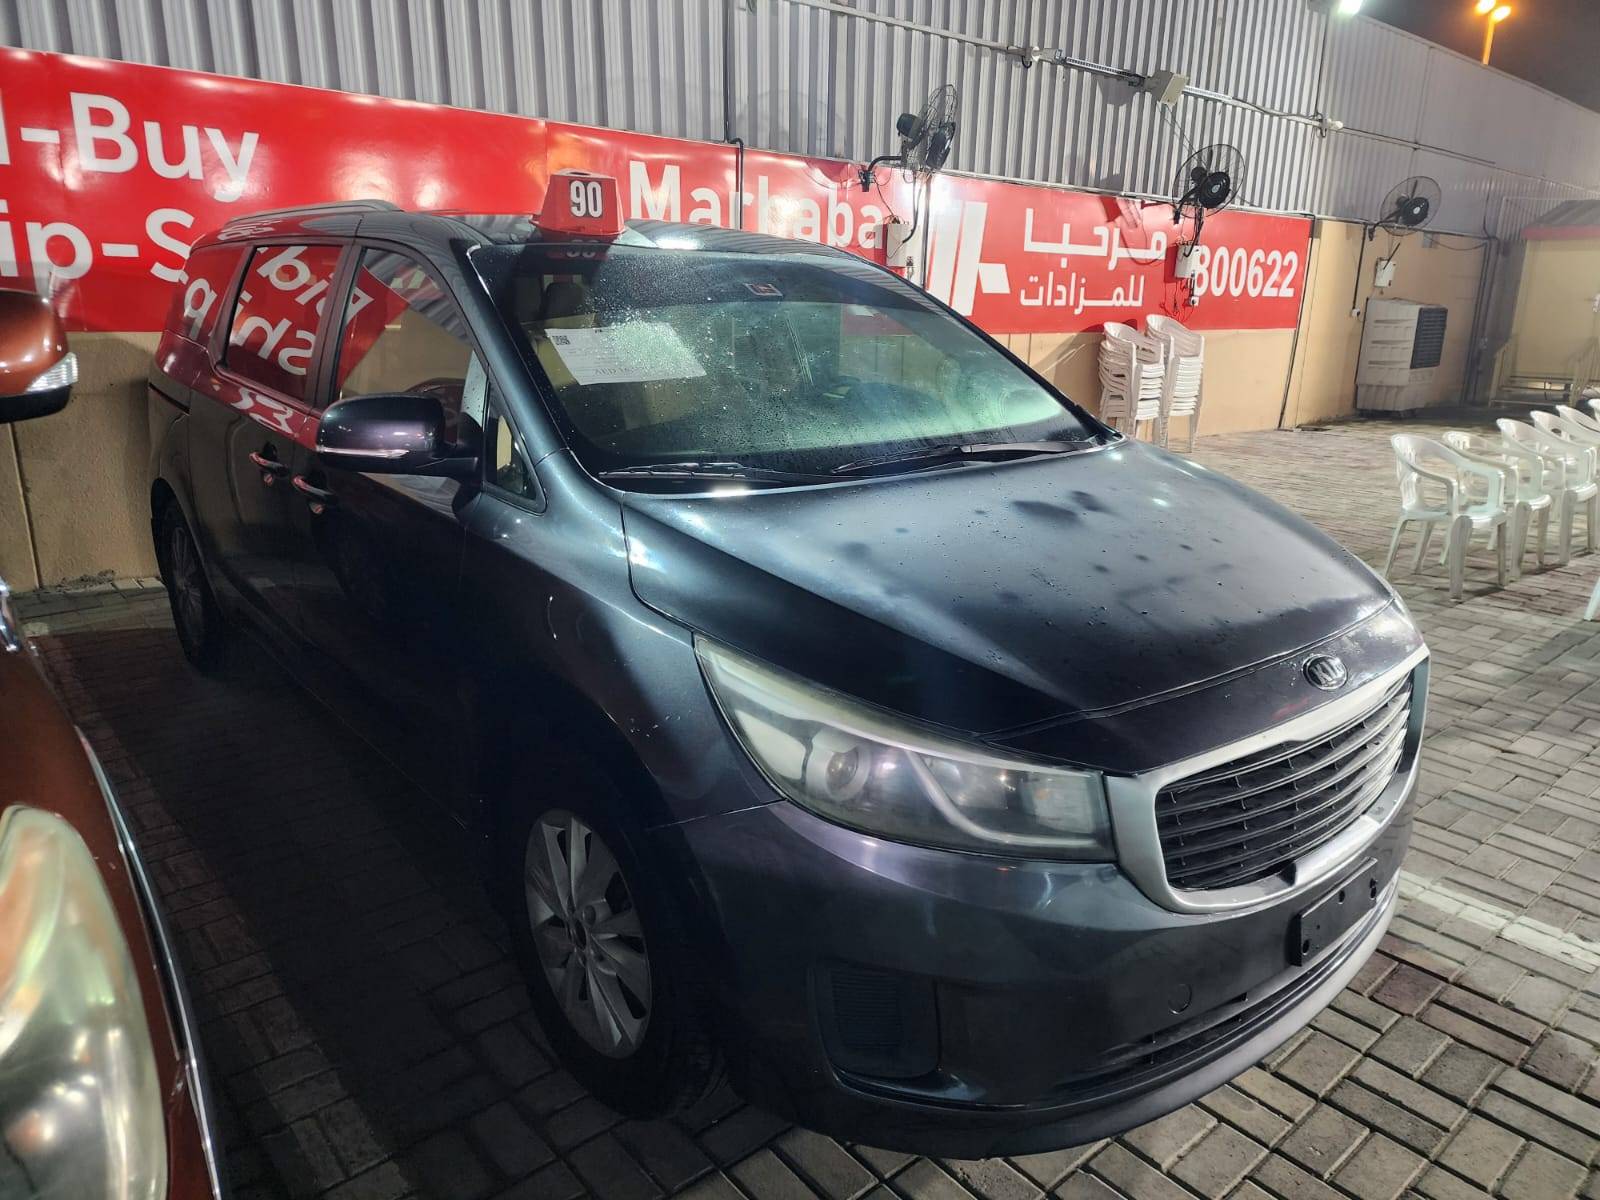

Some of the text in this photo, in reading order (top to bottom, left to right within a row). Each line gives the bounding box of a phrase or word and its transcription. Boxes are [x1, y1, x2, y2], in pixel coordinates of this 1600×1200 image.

[570, 180, 603, 218] 90
[1023, 207, 1168, 271] مرحبا
[1020, 271, 1145, 315] للمزادات
